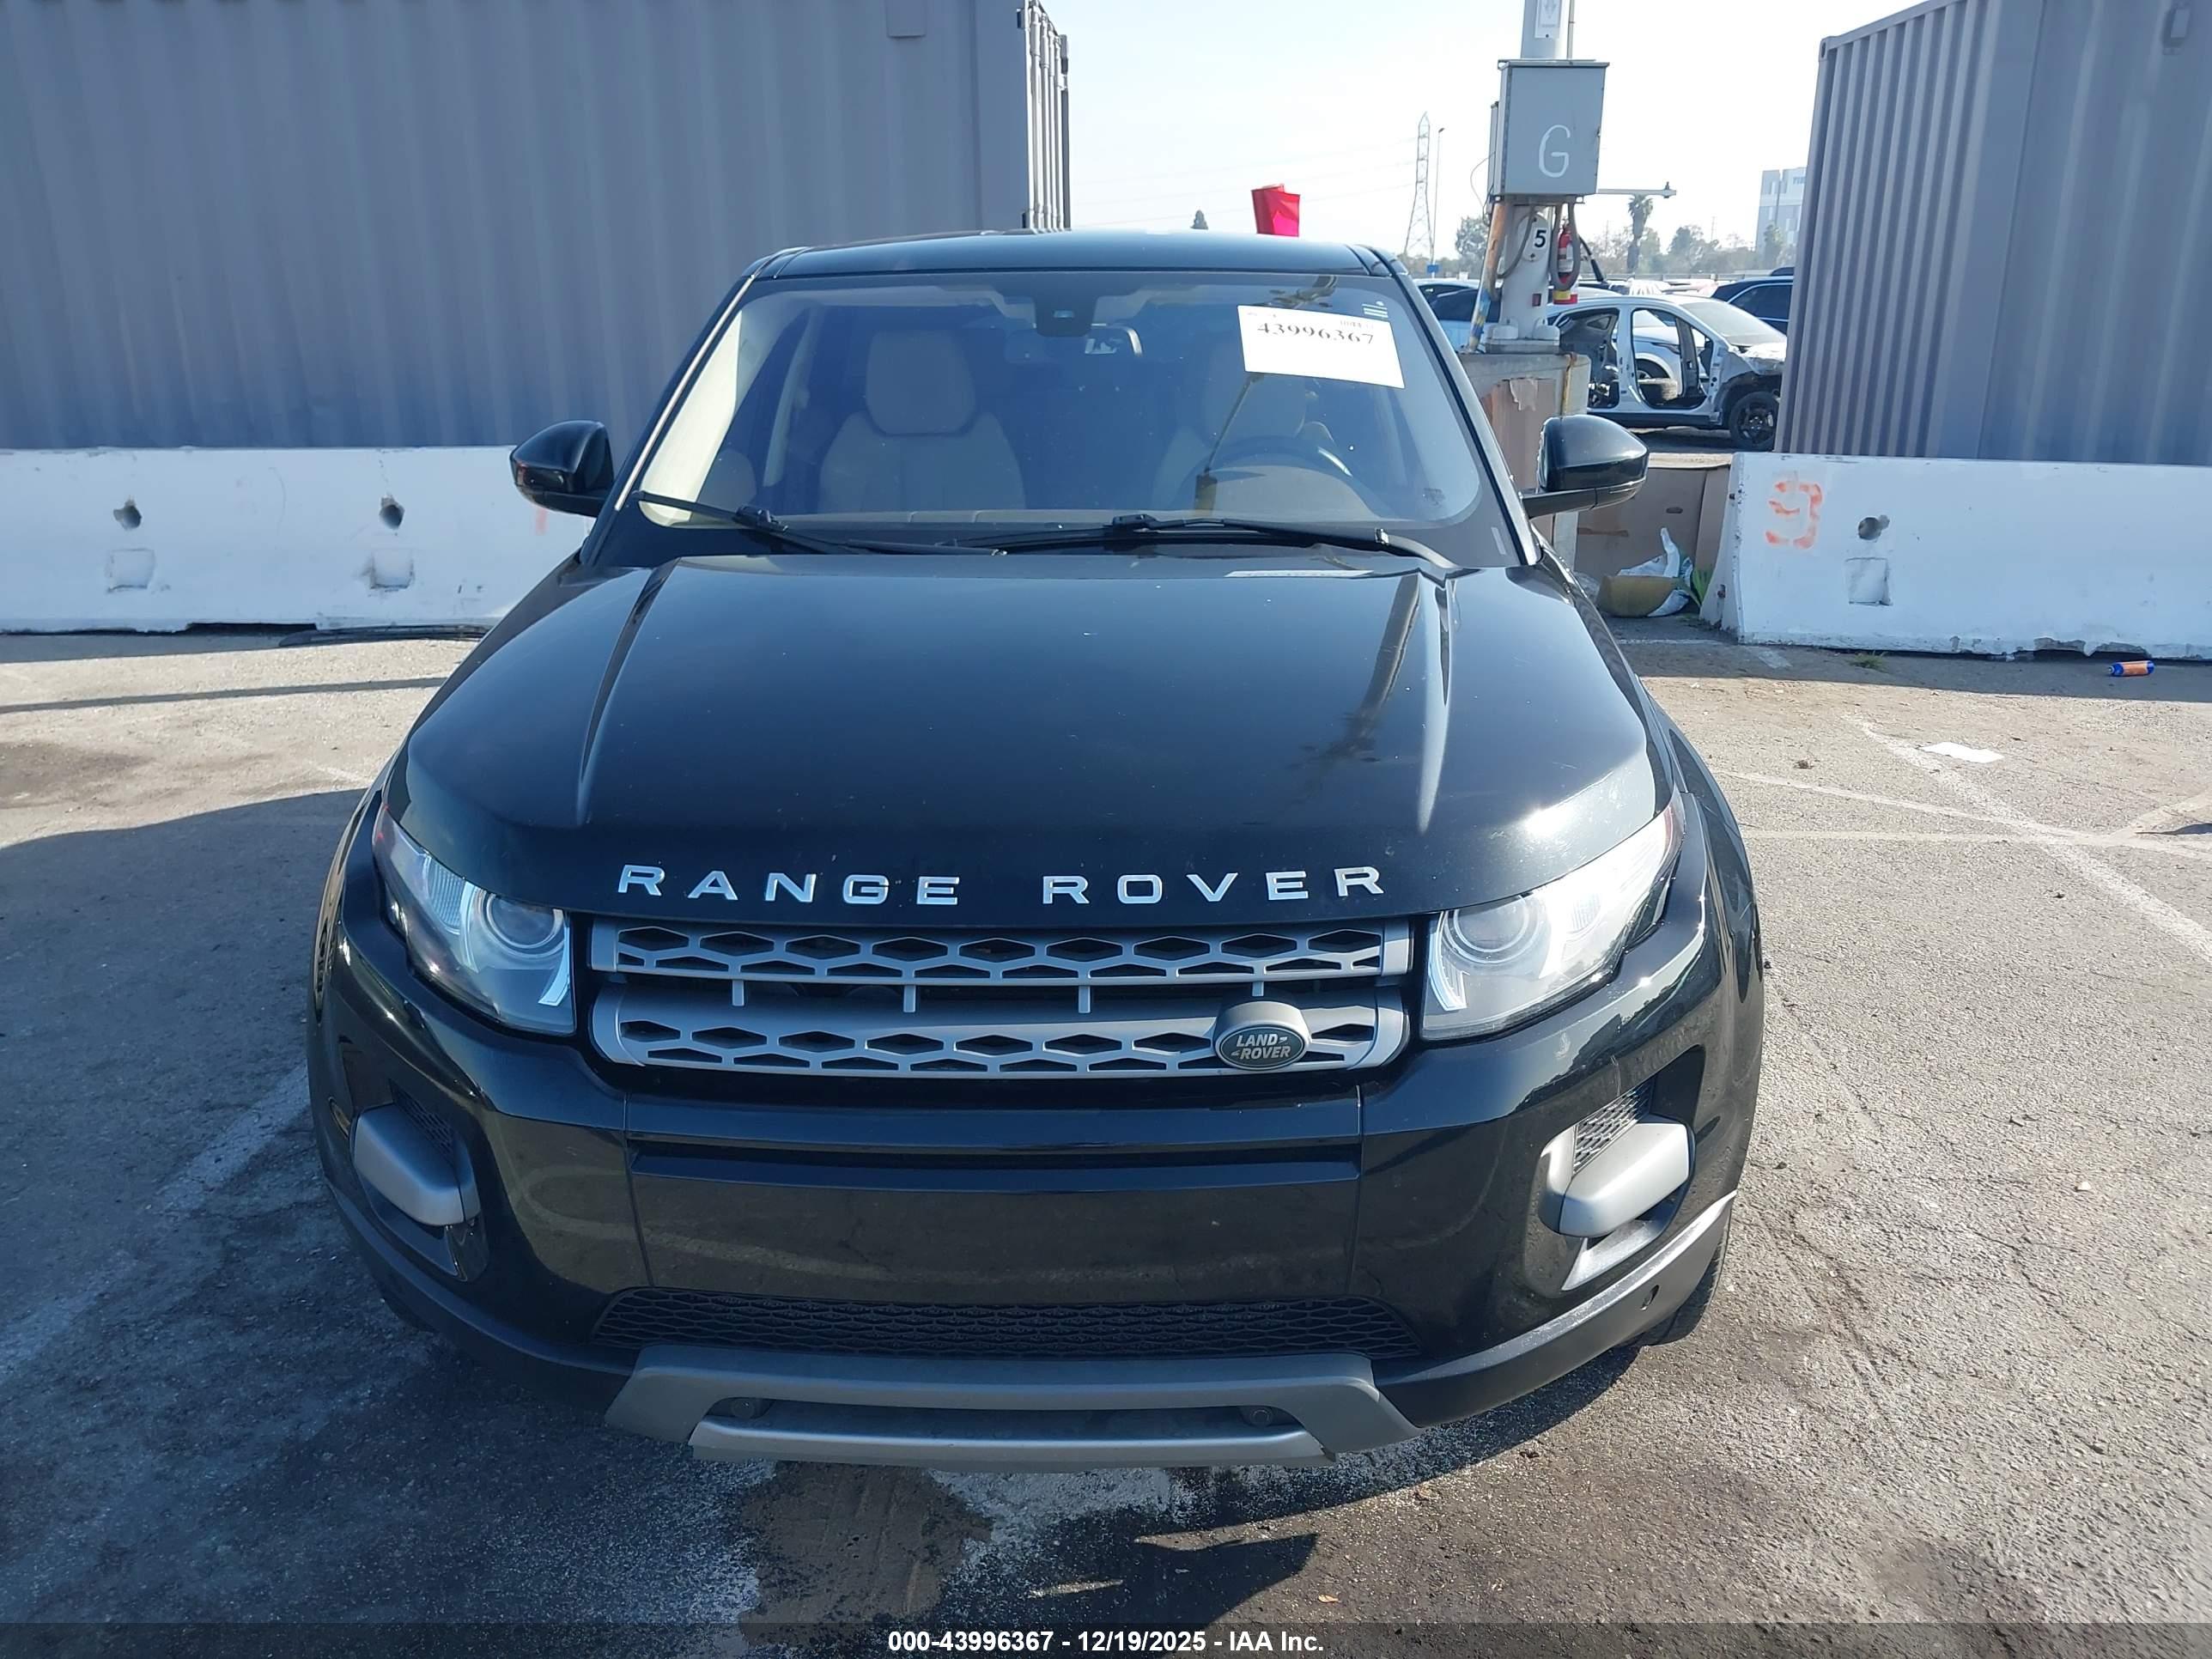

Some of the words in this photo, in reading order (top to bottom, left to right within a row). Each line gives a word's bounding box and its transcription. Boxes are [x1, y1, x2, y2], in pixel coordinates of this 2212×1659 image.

[1539, 125, 1571, 178] G
[1534, 229, 1547, 248] 5
[1257, 322, 1374, 344] 43996367
[617, 864, 960, 905] RANGE
[1042, 866, 1385, 905] ROVER
[1237, 1033, 1279, 1047] LAND
[1239, 1046, 1291, 1060] ROVER
